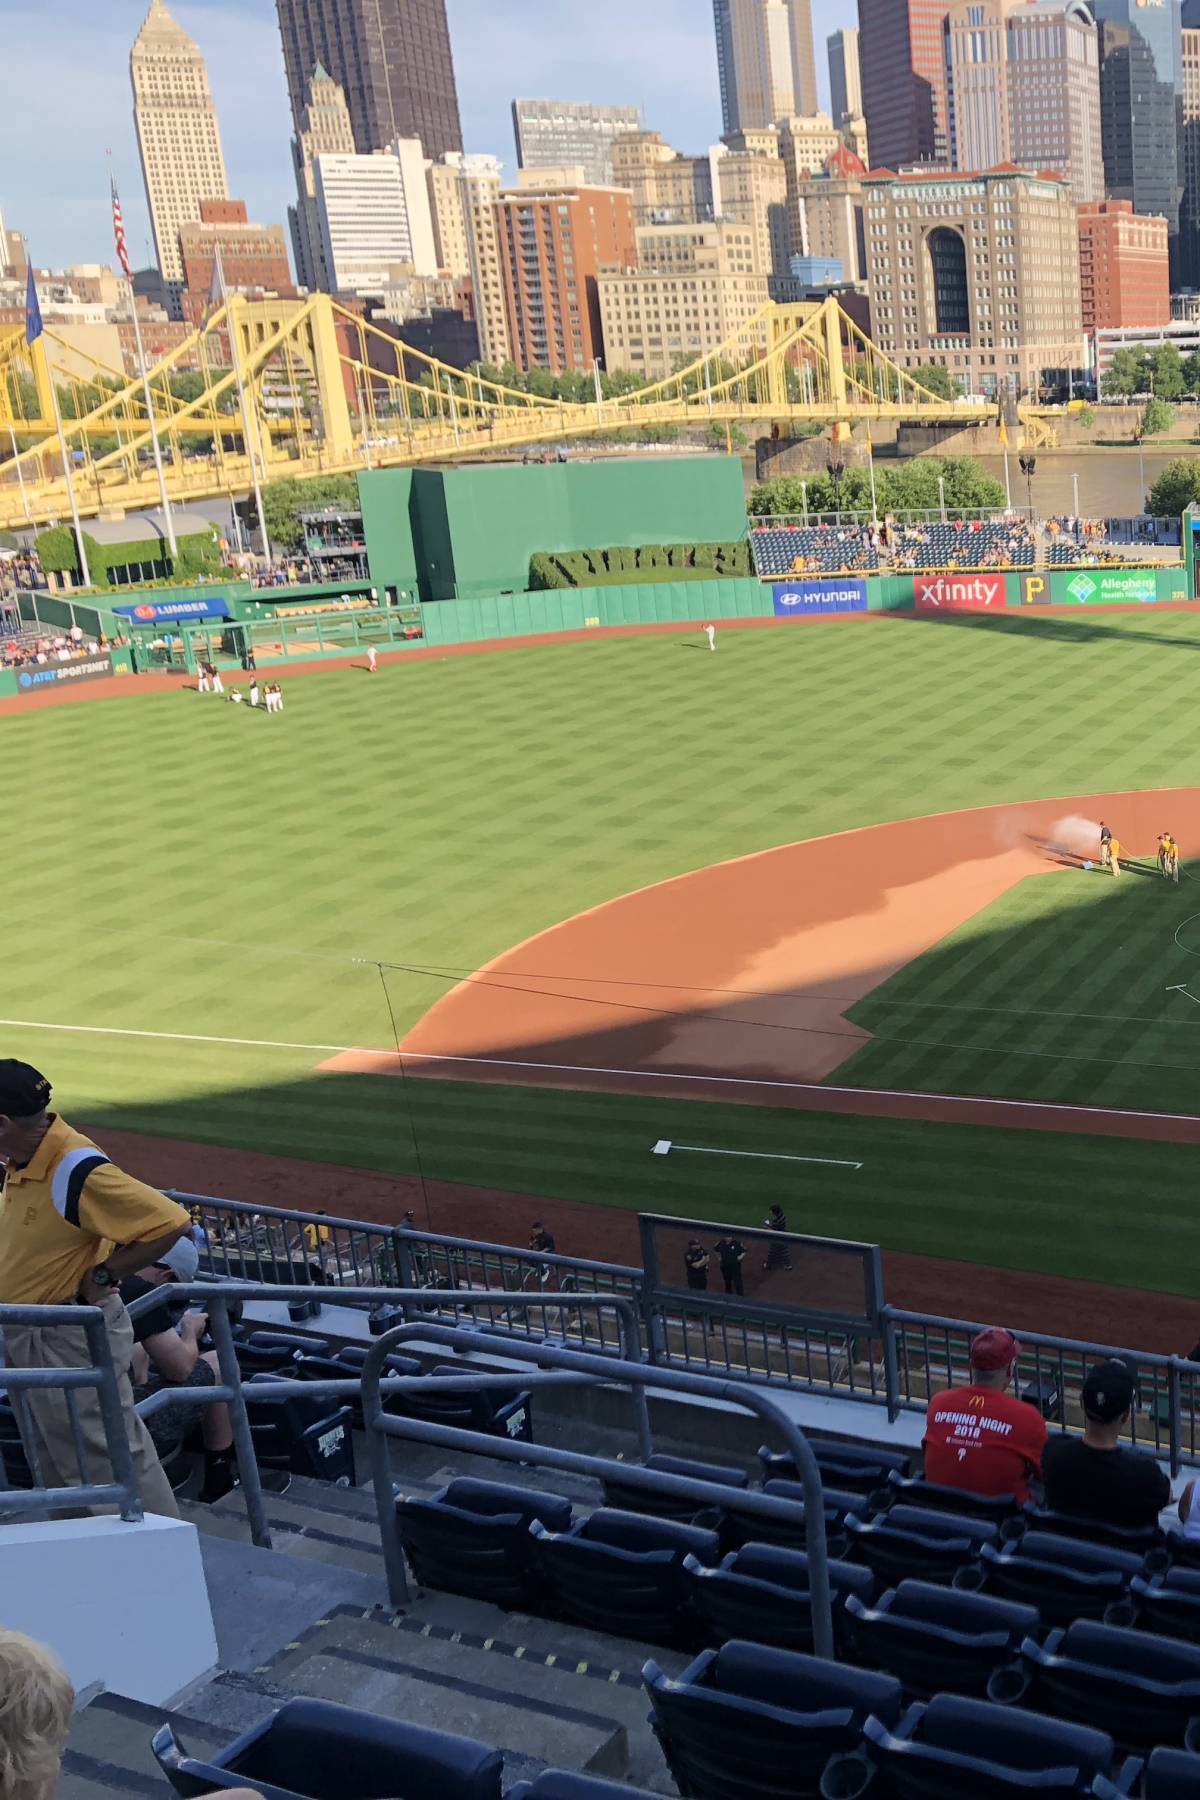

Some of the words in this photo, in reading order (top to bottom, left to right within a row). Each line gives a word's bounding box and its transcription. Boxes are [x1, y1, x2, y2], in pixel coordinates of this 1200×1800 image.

[921, 578, 999, 606] xfinity
[1025, 576, 1045, 604] P
[1101, 577, 1156, 592] Allegheny
[804, 590, 861, 603] HYUNDAI
[157, 602, 208, 616] LUMBER
[32, 668, 58, 684] AT&T
[57, 660, 110, 678] SPORTSNET
[934, 1411, 978, 1426] OPENING
[978, 1416, 1013, 1436] NIGHT
[954, 1424, 981, 1439] 2018
